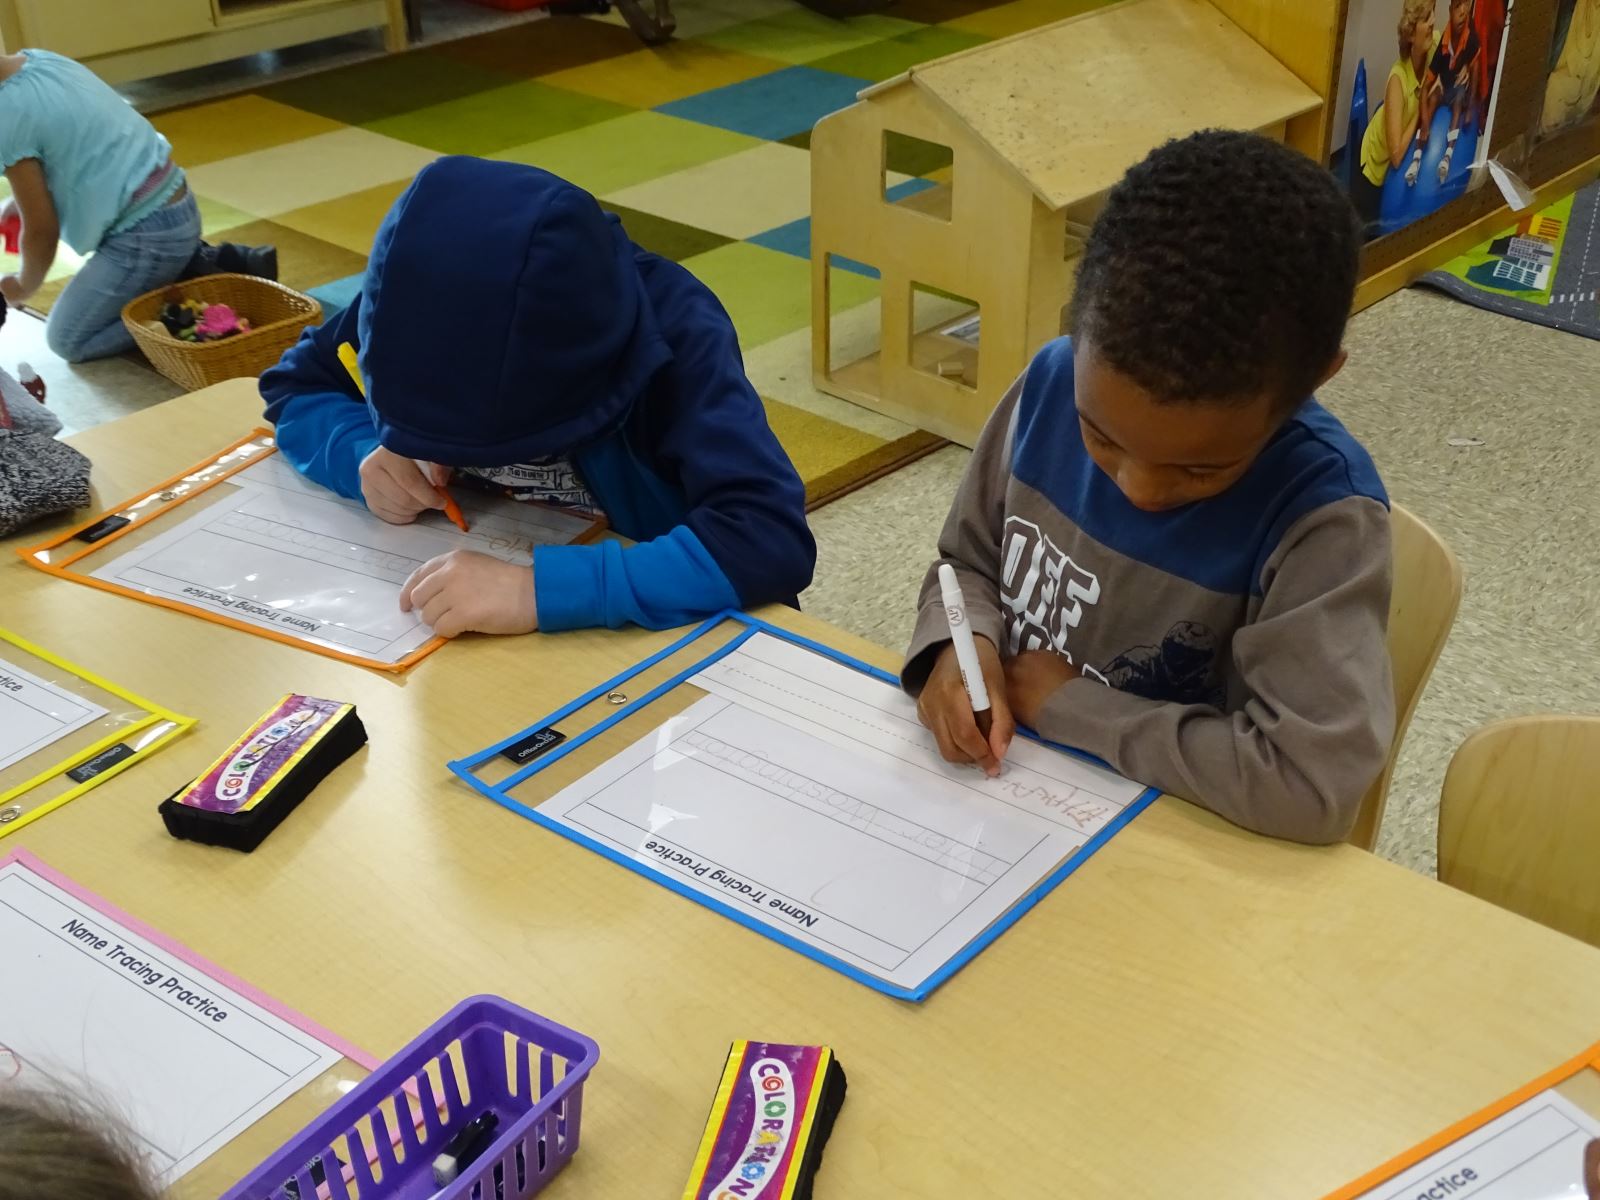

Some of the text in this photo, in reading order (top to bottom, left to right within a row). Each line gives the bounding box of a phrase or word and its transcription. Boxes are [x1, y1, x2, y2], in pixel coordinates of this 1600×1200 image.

[182, 587, 321, 632] Name Tracing Practice
[645, 841, 819, 927] Name Tracing Practice
[61, 919, 228, 1022] Name Tracing Practice
